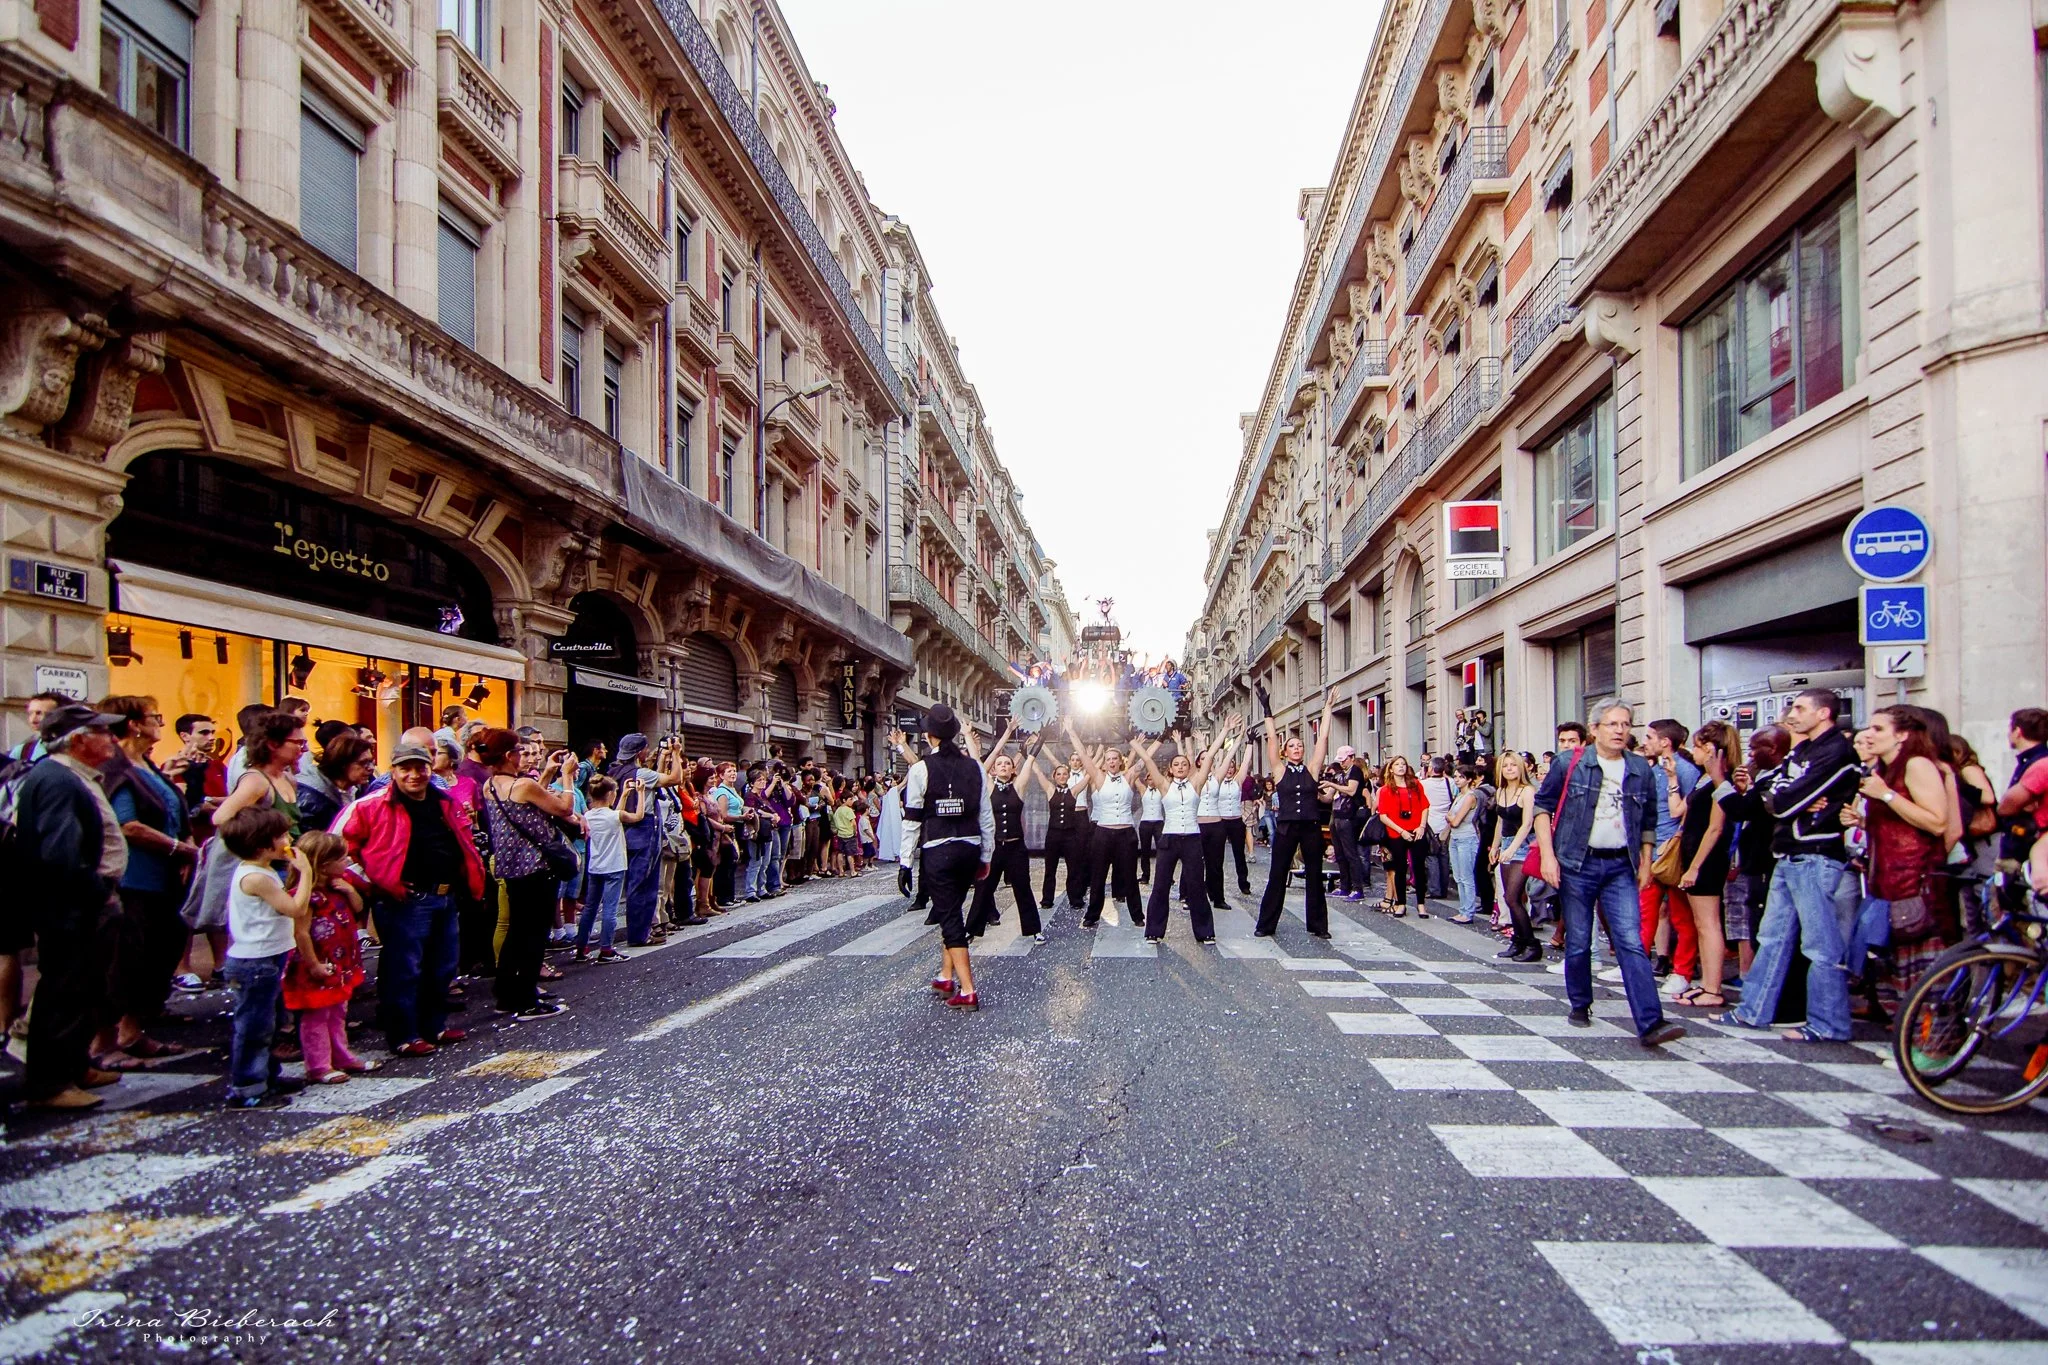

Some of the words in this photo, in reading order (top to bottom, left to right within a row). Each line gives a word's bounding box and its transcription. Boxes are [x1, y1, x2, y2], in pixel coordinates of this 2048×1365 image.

[273, 521, 390, 582] repetto
[50, 568, 71, 580] RUE
[56, 578, 65, 586] DE
[43, 583, 78, 598] METZ
[552, 642, 613, 652] Centreville
[42, 669, 81, 679] CARRIERA
[607, 679, 640, 693] Centreville
[843, 665, 855, 725] HANDY
